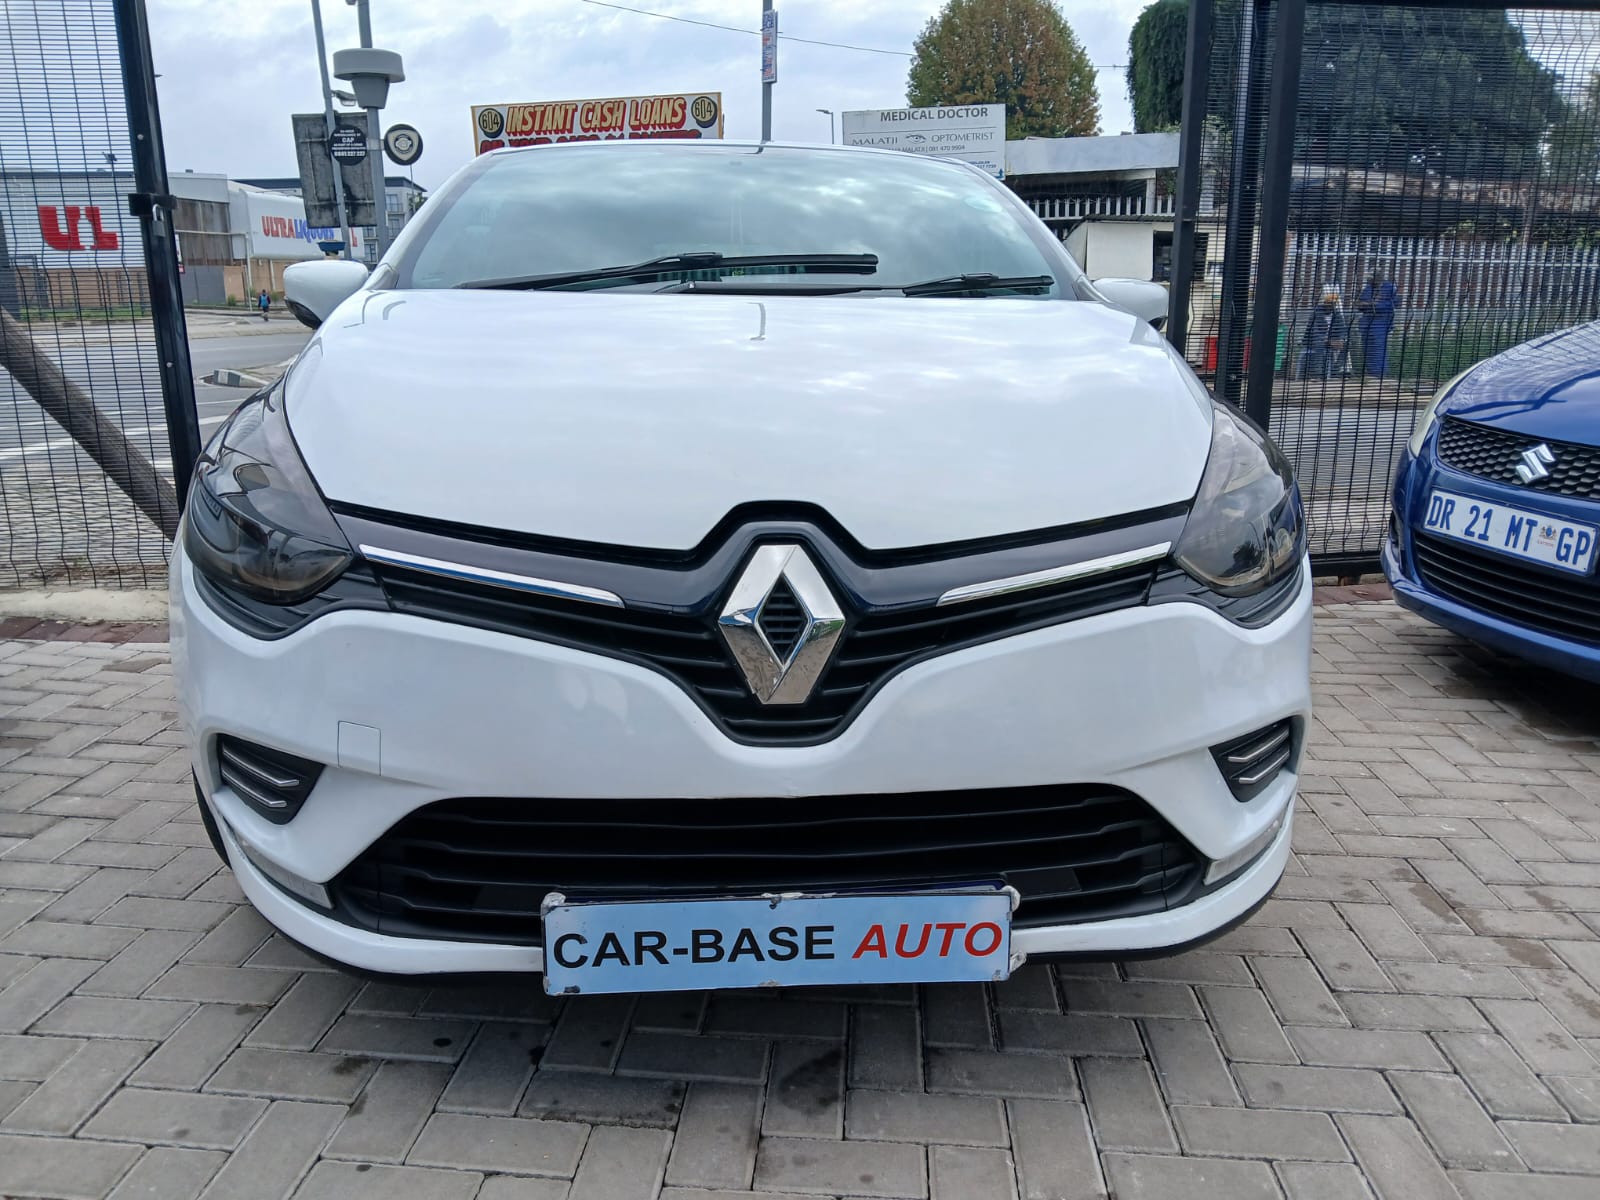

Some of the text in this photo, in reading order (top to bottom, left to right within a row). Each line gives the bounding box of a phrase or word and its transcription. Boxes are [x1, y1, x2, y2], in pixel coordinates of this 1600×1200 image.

[505, 97, 687, 136] INSTANT CASH LOANS
[694, 99, 712, 119] 604
[880, 107, 988, 121] MEDICAL DOCTOR
[482, 111, 500, 130] 604
[931, 132, 995, 142] OPTOMETRIST
[1427, 495, 1591, 565] DR 21 MT GP
[553, 921, 1003, 968] CAR-BASE AUTO
